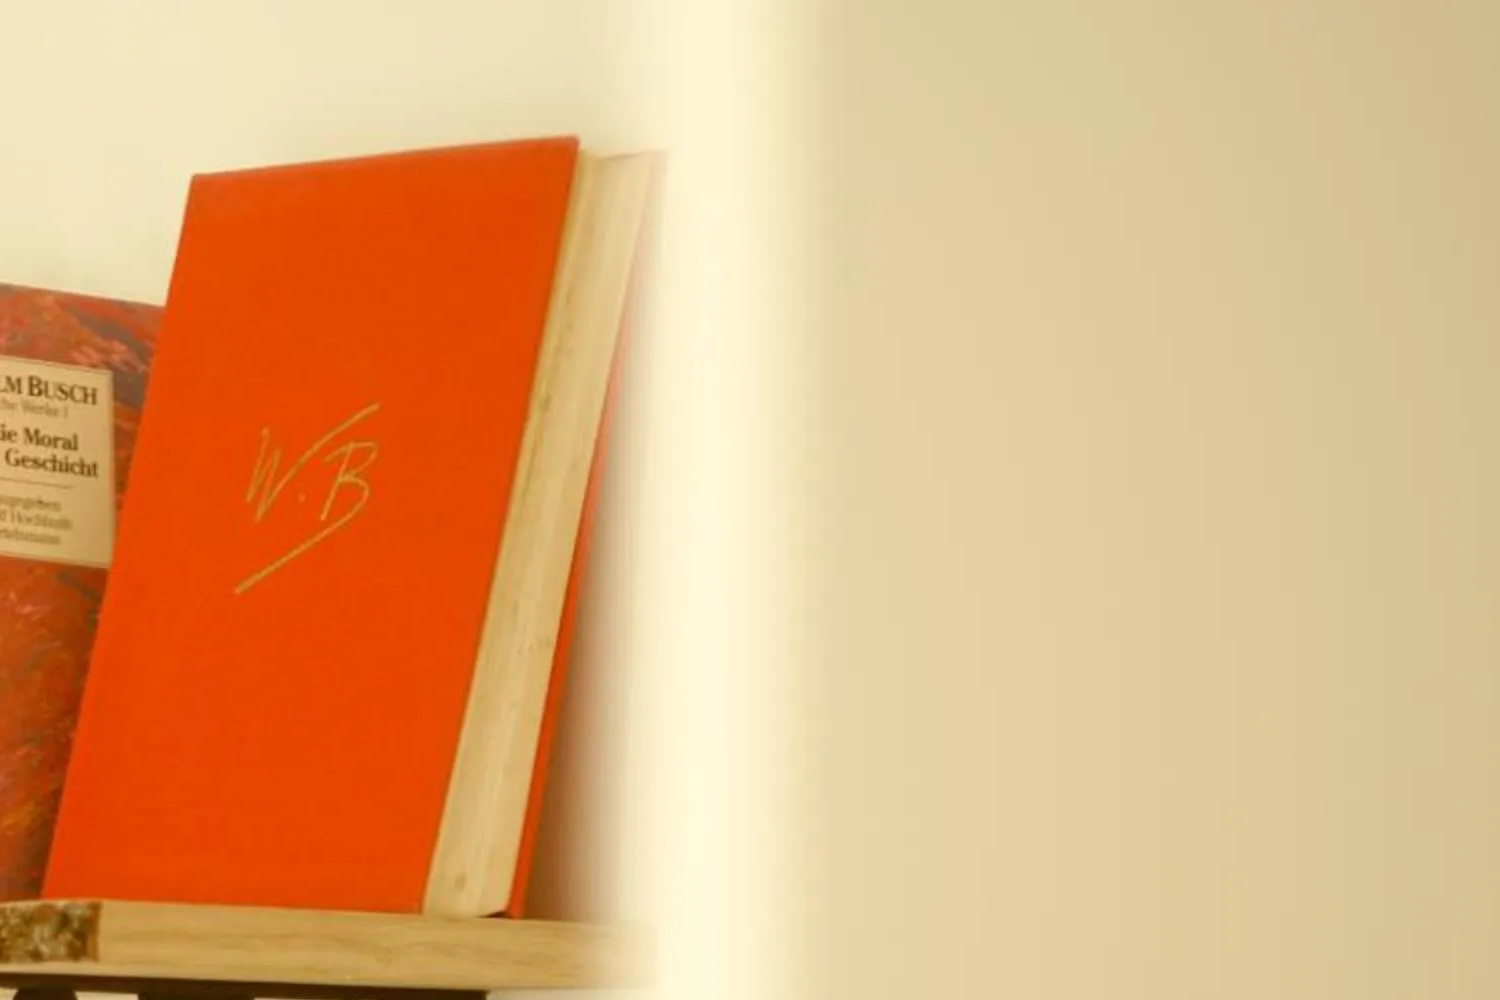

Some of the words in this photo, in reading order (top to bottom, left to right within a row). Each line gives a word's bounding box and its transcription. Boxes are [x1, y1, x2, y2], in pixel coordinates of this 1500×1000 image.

[27, 375, 99, 406] BUSCH
[23, 427, 79, 451] Moral
[5, 448, 99, 478] Geschicht
